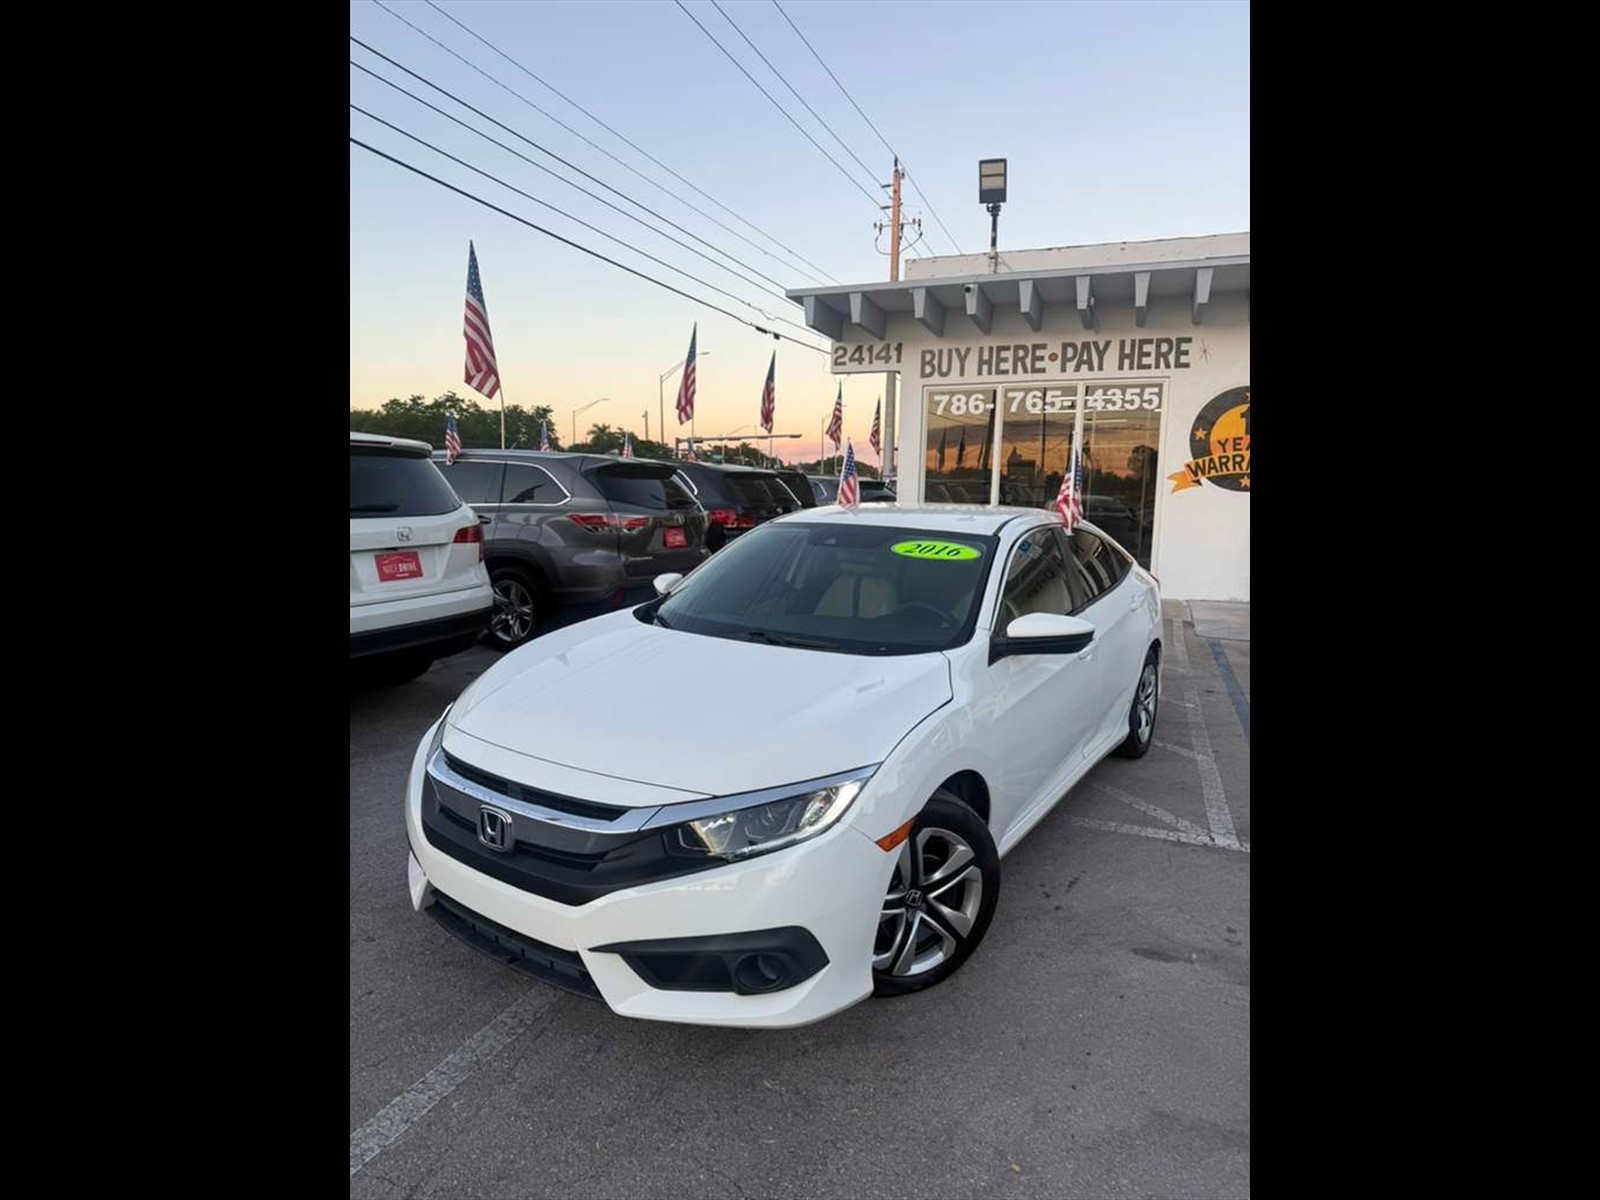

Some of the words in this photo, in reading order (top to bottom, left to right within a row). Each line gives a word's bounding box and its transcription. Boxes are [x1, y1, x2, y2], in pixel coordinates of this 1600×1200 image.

[833, 342, 903, 366] 24141
[920, 347, 971, 378] BUY
[977, 343, 1047, 376] HERE
[1060, 340, 1111, 373] PAY
[1117, 337, 1192, 370] HERE
[933, 393, 994, 415] 786-
[1007, 391, 1072, 414] 765-
[1087, 387, 1159, 410] 4355
[903, 543, 964, 557] 2016
